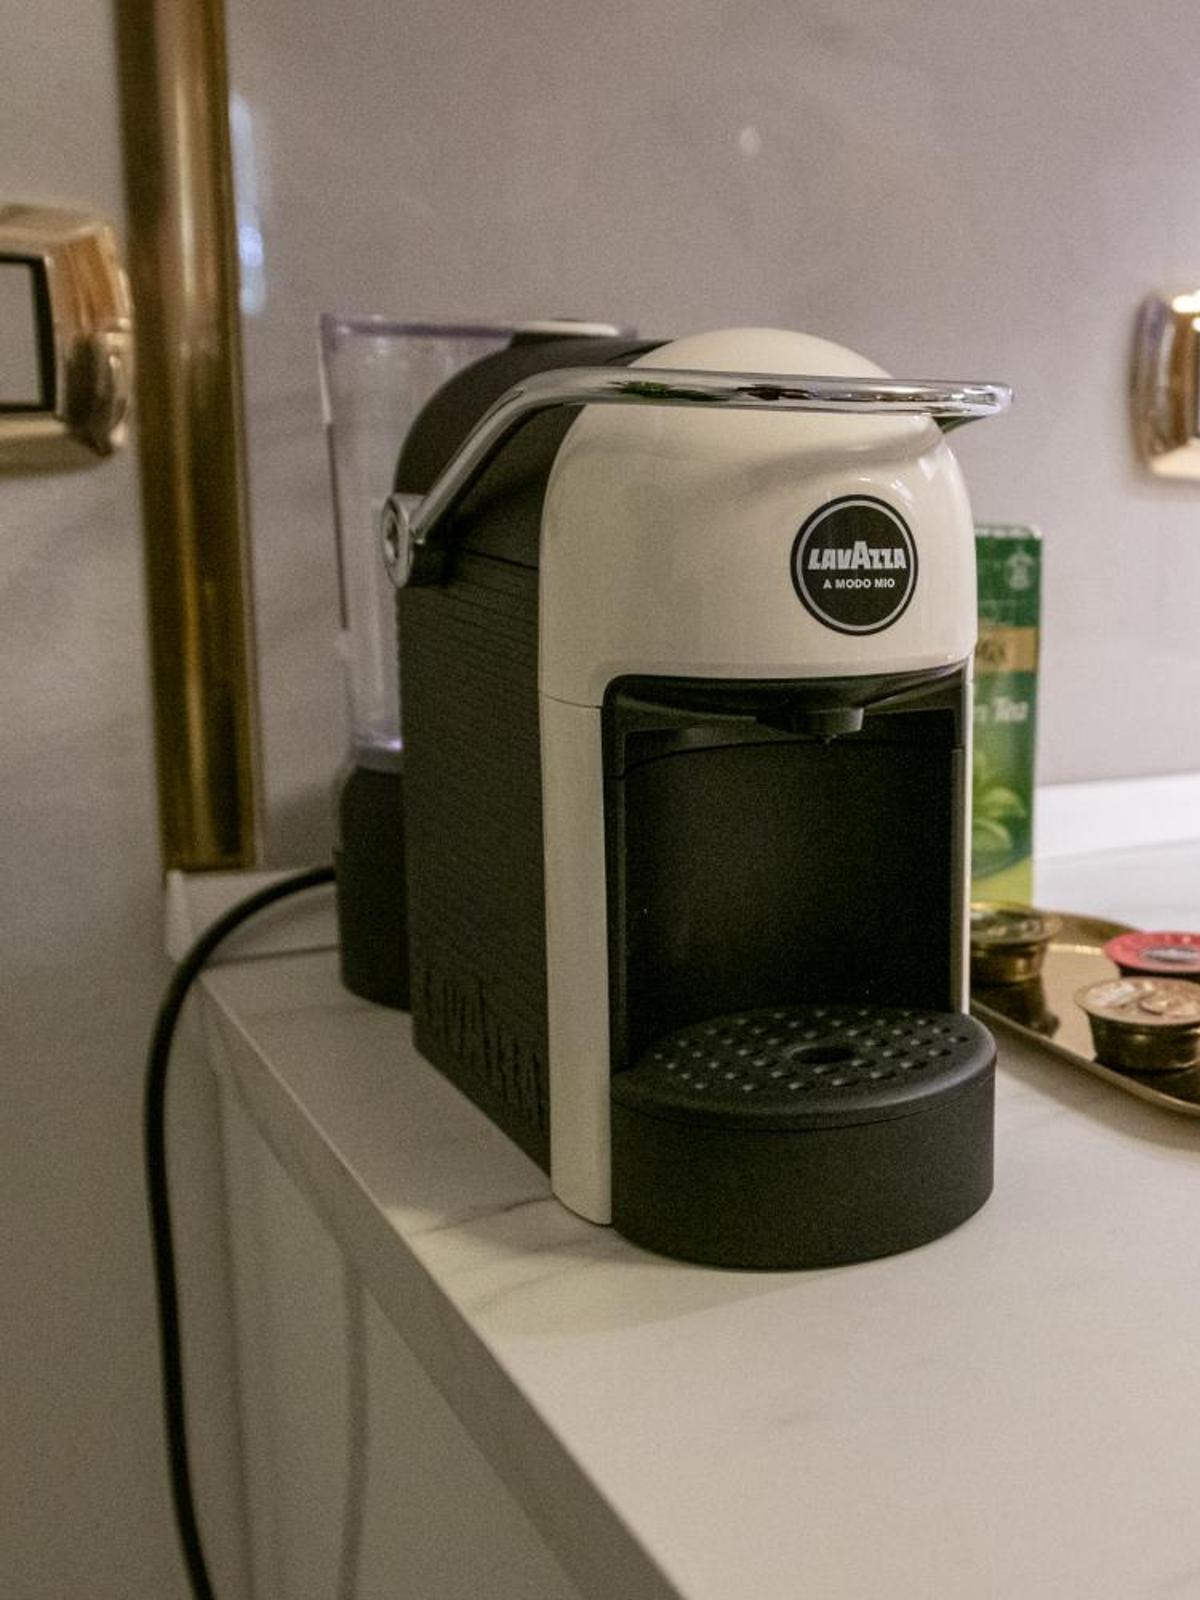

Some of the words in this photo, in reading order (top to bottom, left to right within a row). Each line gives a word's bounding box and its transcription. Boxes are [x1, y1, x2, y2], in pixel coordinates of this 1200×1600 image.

[808, 541, 907, 570] LAVAZZA
[823, 579, 833, 590] A
[835, 579, 872, 589] MODO
[874, 578, 895, 588] MIO
